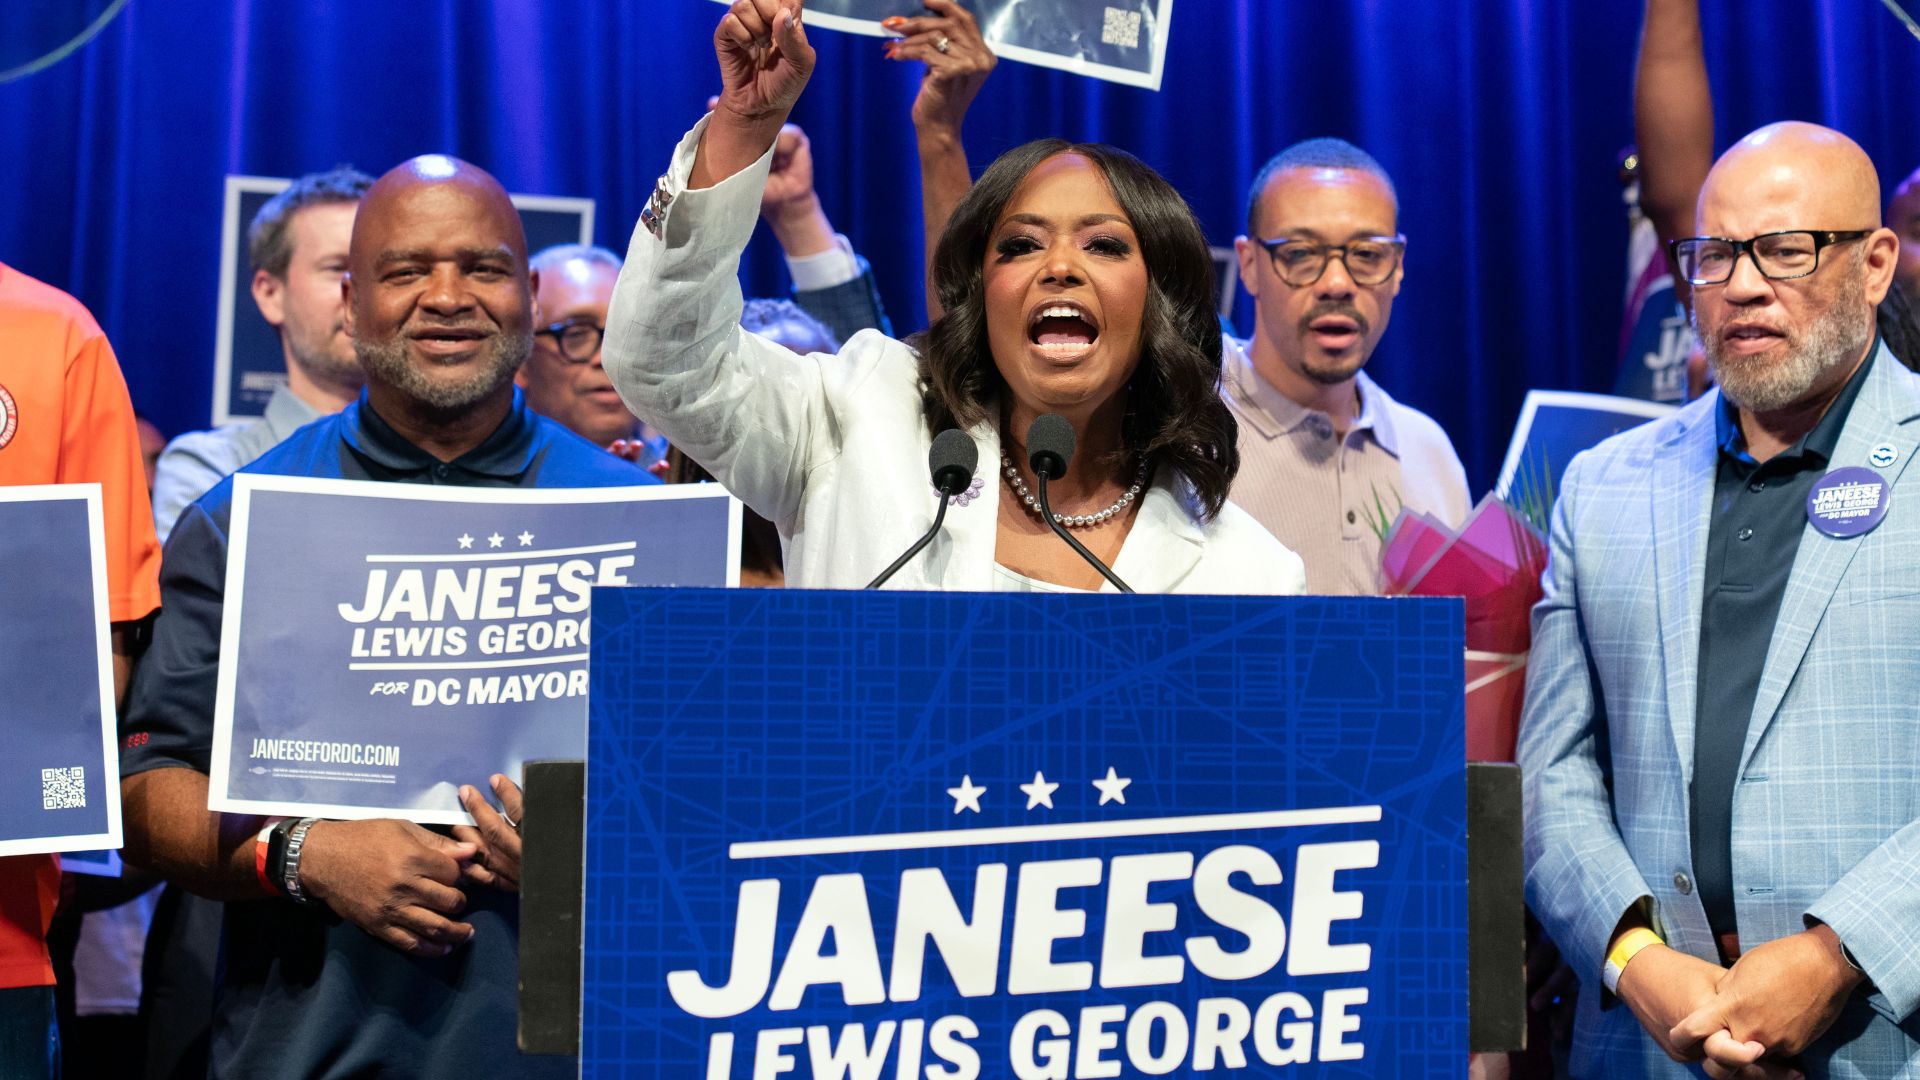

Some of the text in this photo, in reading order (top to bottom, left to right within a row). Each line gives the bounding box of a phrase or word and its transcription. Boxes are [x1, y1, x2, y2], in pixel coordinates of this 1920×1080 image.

[1812, 487, 1881, 504] JANEESE
[1840, 509, 1870, 518] MAYOR
[351, 617, 590, 657] LEWIS GEOR
[370, 670, 588, 706] FOR DC MAYOR
[250, 738, 400, 766] JANEESEFORDC.COM
[667, 840, 1380, 1018] JANEESE
[706, 988, 1369, 1080] LEWIS GEORGE
